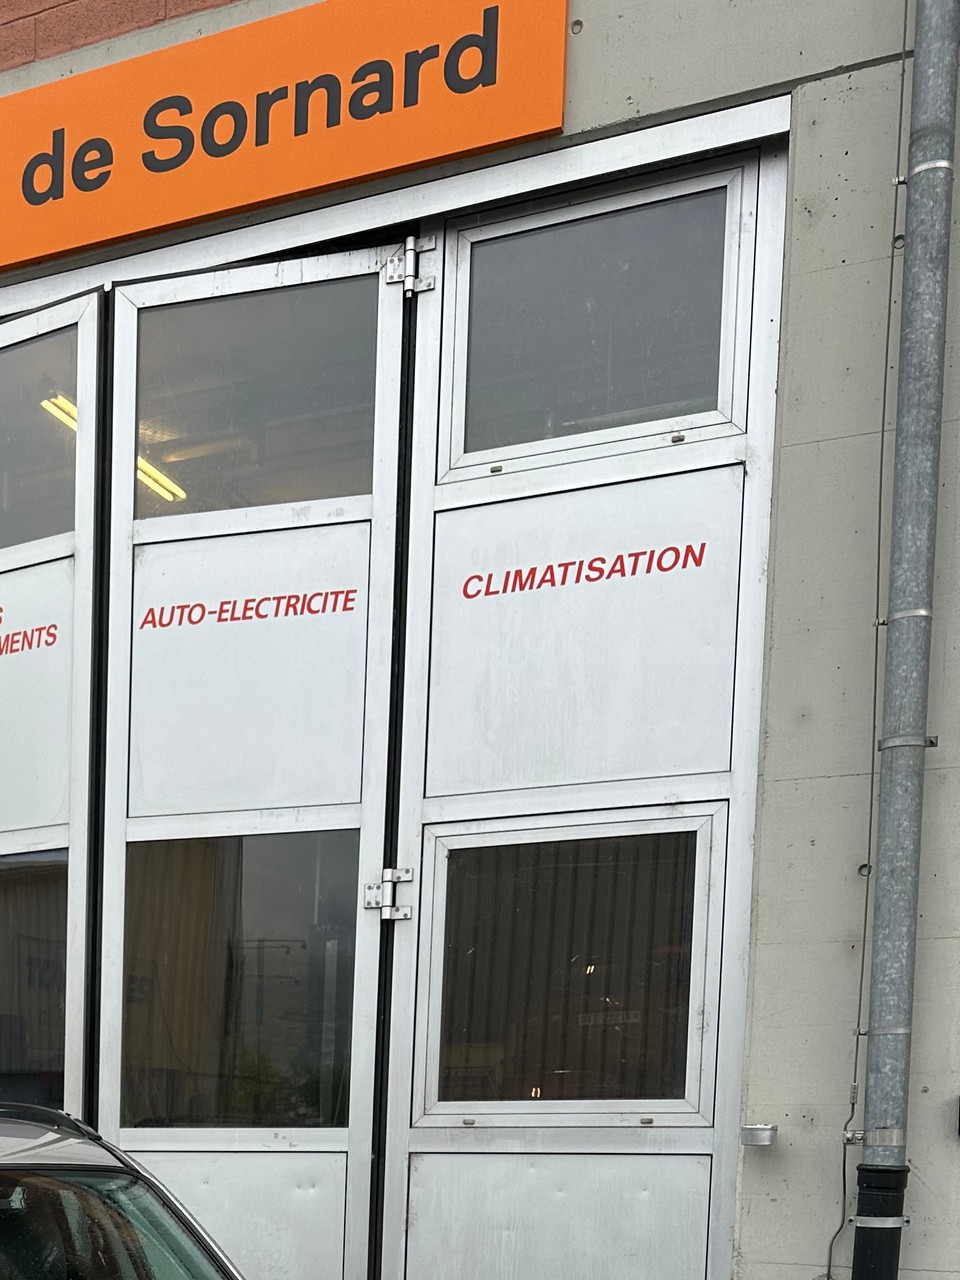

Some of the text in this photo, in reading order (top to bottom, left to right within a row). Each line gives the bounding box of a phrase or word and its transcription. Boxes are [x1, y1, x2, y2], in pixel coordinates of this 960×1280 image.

[22, 128, 113, 206] de
[141, 5, 500, 174] Sornard
[462, 543, 706, 600] CLIMATISATION
[140, 588, 357, 629] AUTO-ELECTRICITE
